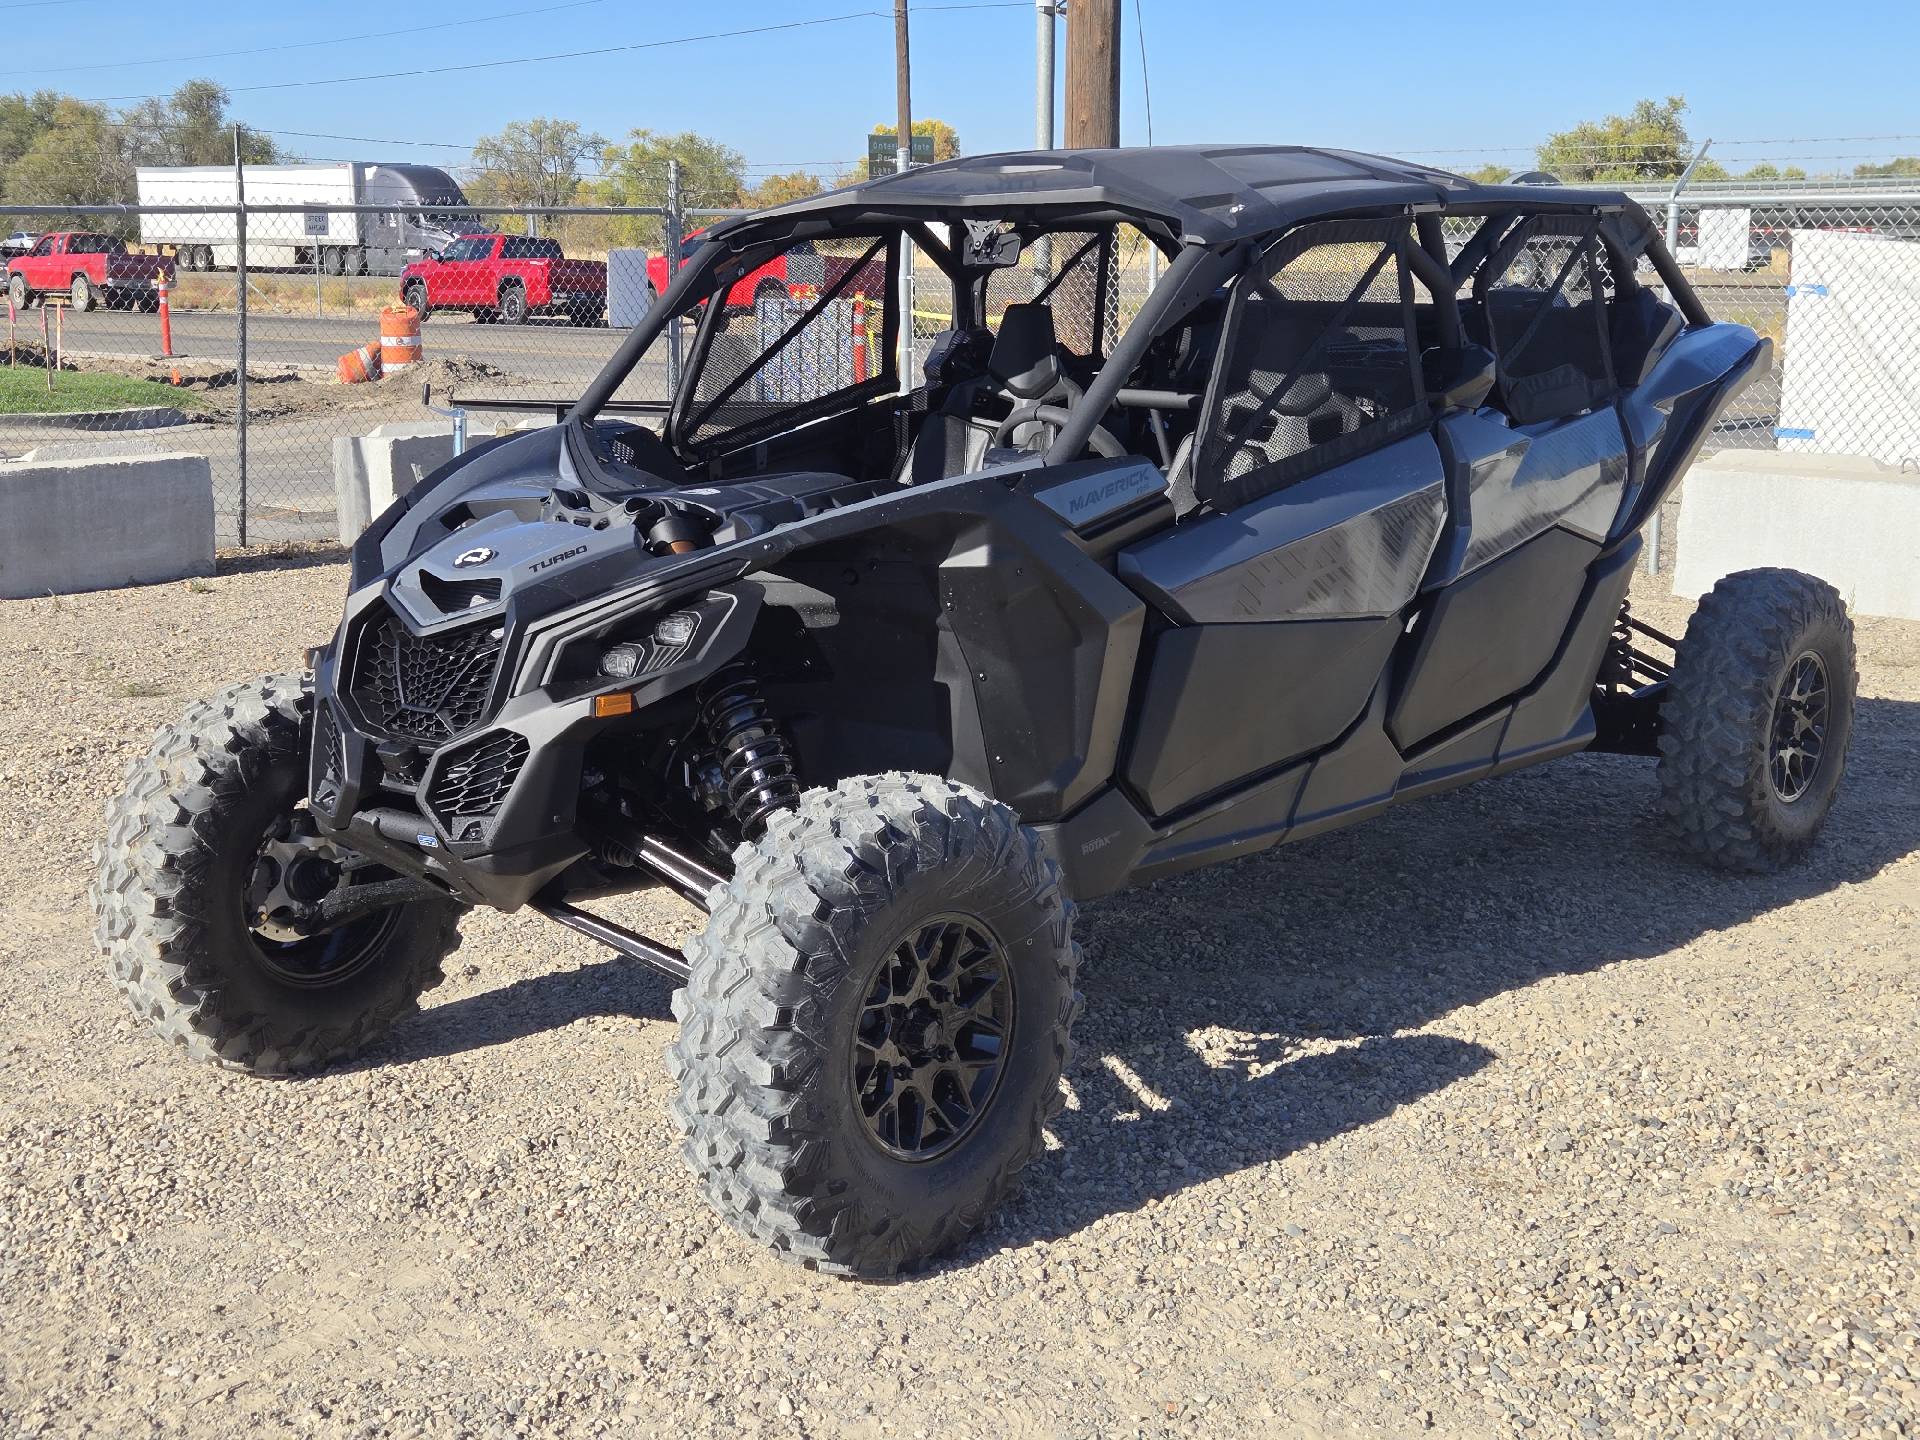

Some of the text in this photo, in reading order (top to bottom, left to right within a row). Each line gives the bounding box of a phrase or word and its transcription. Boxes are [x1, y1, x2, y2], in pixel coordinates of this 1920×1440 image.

[873, 142, 899, 150] Ontari
[1069, 467, 1149, 514] MAVERICK
[529, 545, 588, 573] TURBO
